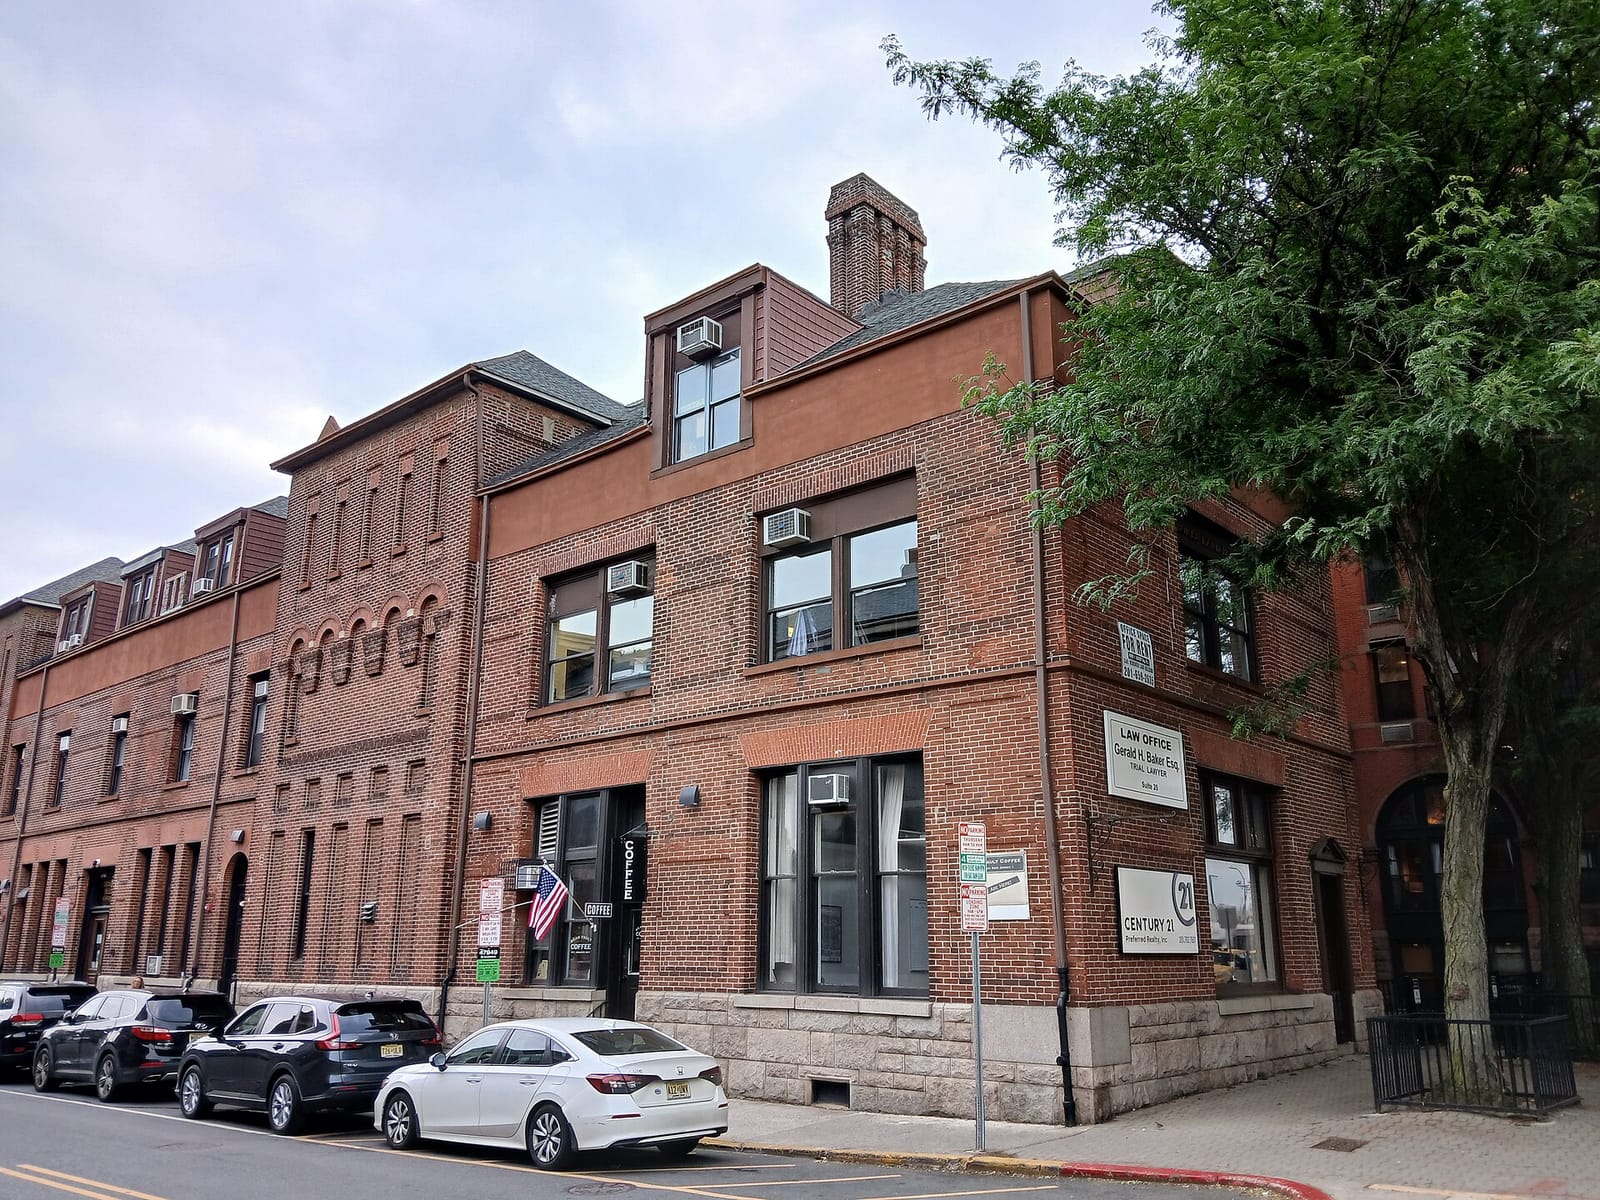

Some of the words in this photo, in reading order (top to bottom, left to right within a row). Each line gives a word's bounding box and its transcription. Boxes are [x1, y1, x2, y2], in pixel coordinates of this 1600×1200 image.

[1122, 634, 1136, 652] FOR
[1136, 639, 1151, 659] RENT
[1120, 728, 1140, 742] LAW
[1142, 734, 1172, 751] OFFICE
[1114, 743, 1136, 759] Gerald
[1146, 751, 1165, 766] Baker
[1130, 762, 1145, 773] TRIAL
[1146, 766, 1167, 778] LAWYER
[624, 840, 634, 900] COFFEE
[1178, 882, 1194, 909] 21
[586, 904, 611, 916] COFFEE
[1124, 917, 1165, 932] CENTURY
[1166, 919, 1175, 932] 21
[1125, 935, 1146, 943] Preferred
